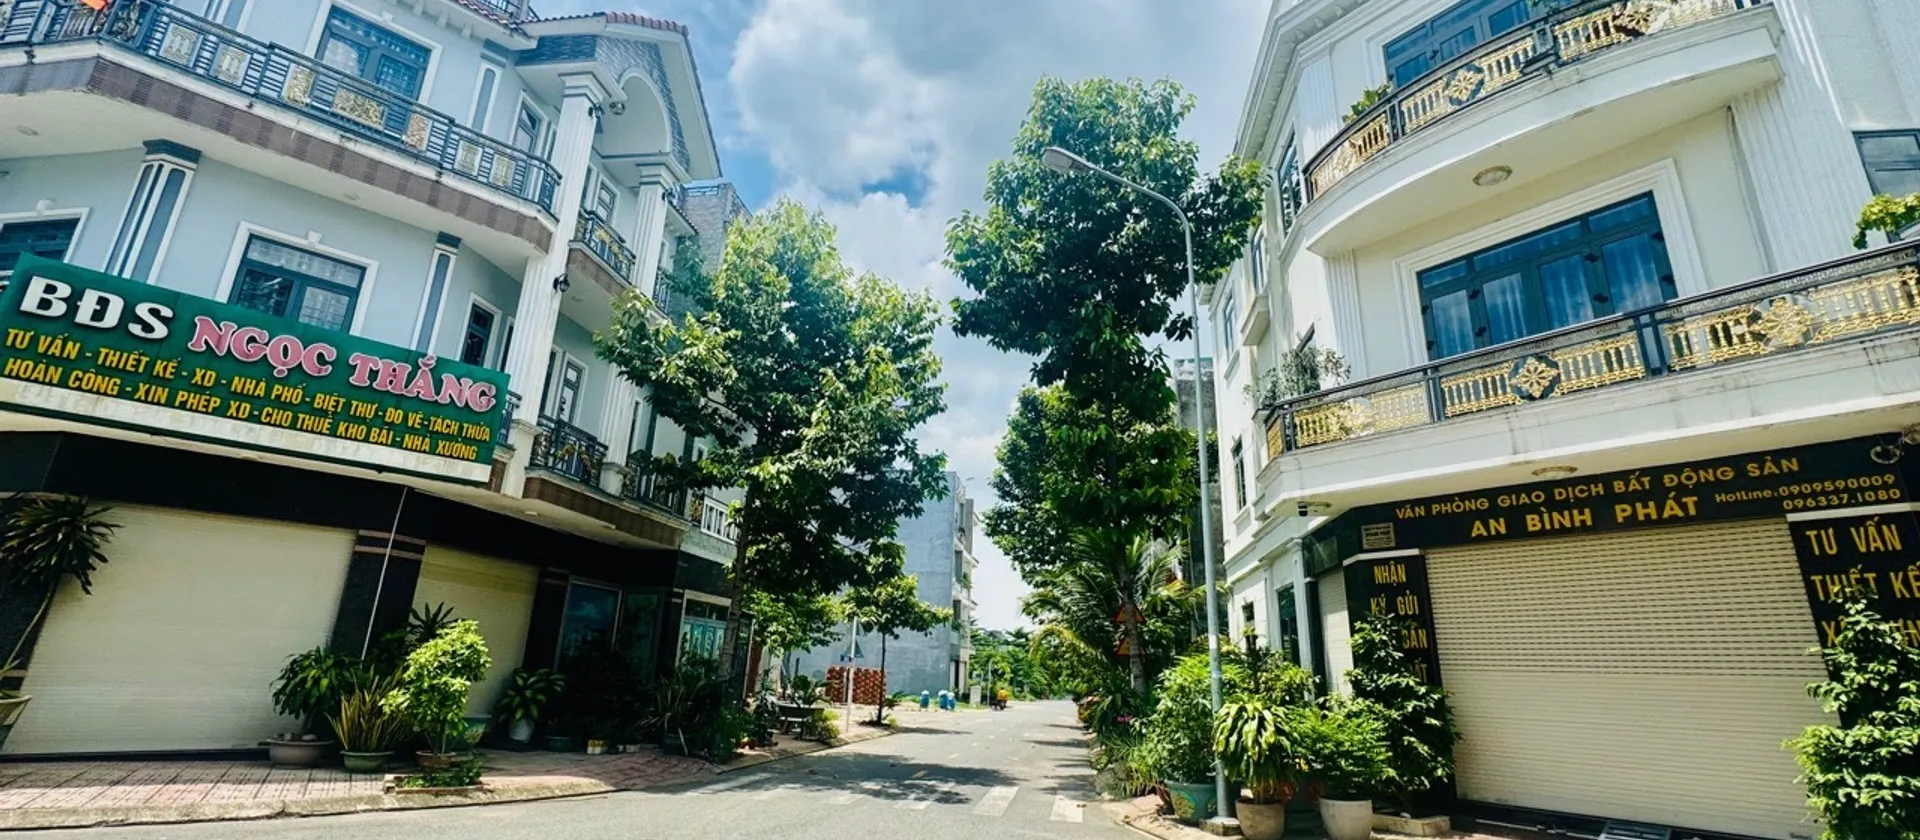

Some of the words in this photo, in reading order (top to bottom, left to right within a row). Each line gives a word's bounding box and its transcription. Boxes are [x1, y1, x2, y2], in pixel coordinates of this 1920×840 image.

[20, 275, 174, 340] BĐS
[188, 316, 337, 377] NGỌC
[348, 354, 496, 412] THẮNG
[3, 357, 63, 384] HOÀN
[68, 368, 121, 396] CÔNG
[134, 382, 169, 405] XIN
[174, 390, 221, 413] PHÉP
[227, 400, 251, 419] XD
[261, 407, 293, 427] CHO
[336, 421, 367, 440] KHO
[369, 426, 394, 445] BÃI
[402, 433, 431, 452] NHÀ
[5, 328, 35, 349] TƯ
[37, 333, 81, 360] VẤN
[97, 347, 150, 373] THIẾT
[153, 357, 181, 379] KẾ
[191, 367, 217, 387] XD
[230, 376, 266, 397] NHÀ
[270, 382, 306, 405] PHỐ
[313, 392, 346, 414] BIỆT
[349, 400, 379, 422] THỰ
[384, 407, 404, 425] ĐO
[1395, 504, 1426, 520] VĂN
[1431, 497, 1489, 516] PHÒNG
[1497, 490, 1545, 508] GIAO
[1554, 483, 1604, 502] DỊCH
[1613, 471, 1652, 494] BẤT
[1663, 466, 1735, 488] ĐỘNG
[1747, 455, 1800, 477] SẢN
[1471, 518, 1507, 538] AN
[1525, 506, 1593, 532] BÌNH
[1614, 491, 1698, 523] PHÁT
[1850, 516, 1903, 553] VẤN
[1373, 560, 1407, 587] NHẬN
